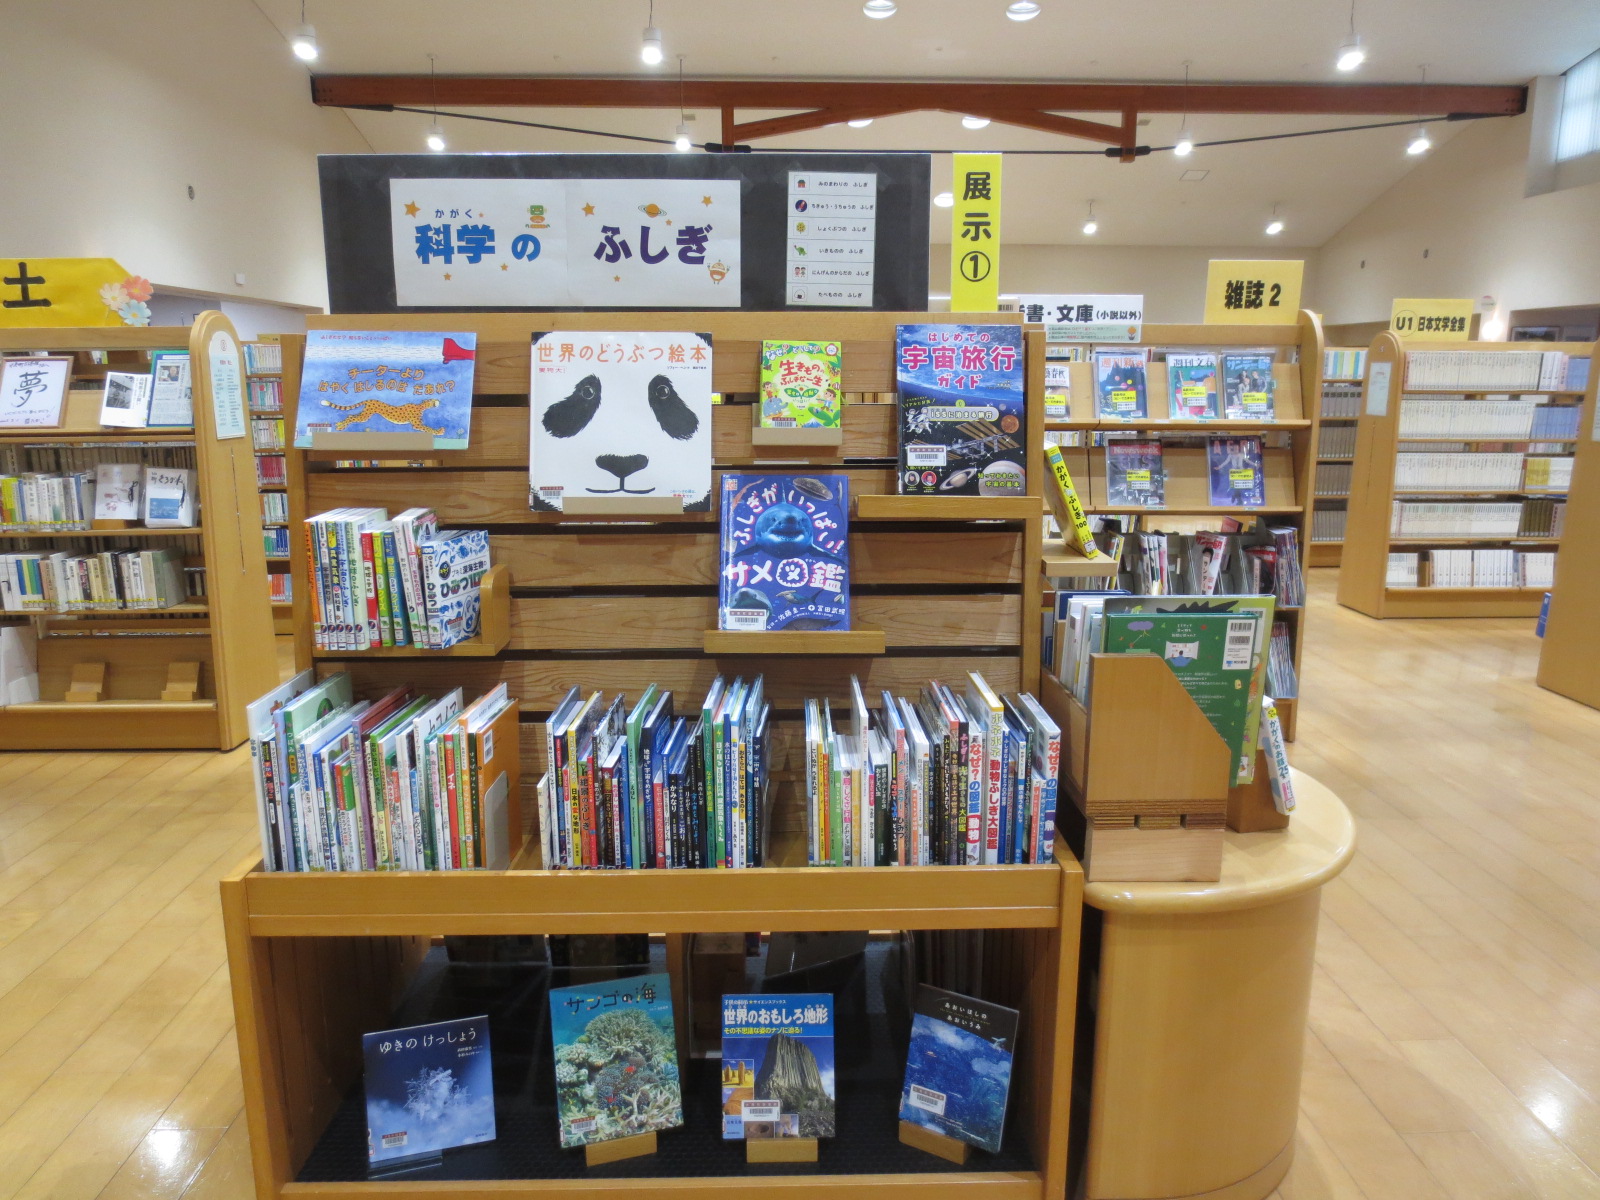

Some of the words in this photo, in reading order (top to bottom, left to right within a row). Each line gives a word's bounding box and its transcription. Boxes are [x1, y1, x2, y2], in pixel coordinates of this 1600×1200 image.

[435, 208, 472, 218] かがく
[594, 224, 713, 264] ふしぎ
[1396, 317, 1413, 330] U1
[1418, 316, 1466, 332] 日本文学全集
[928, 332, 990, 342] はじめての
[538, 343, 707, 363] 世界のどうぶつ絵本
[902, 345, 1016, 371] 宇宙旅行
[1172, 357, 1216, 368] 週刊文春
[348, 365, 426, 380] チーターより
[12, 371, 48, 408] 夢
[318, 380, 350, 394] はやく
[354, 379, 408, 394] はしるのは
[412, 380, 456, 395] だあれ?
[938, 374, 982, 389] ガイド
[1114, 446, 1160, 454] Newsweek
[447, 775, 456, 790] イネ
[968, 743, 982, 814] なぜ?の図鑑
[1047, 741, 1060, 812] なぜ?の図鑑
[986, 759, 1000, 849] 動物ふしぎ大図鑑
[968, 817, 980, 841] 動物
[564, 982, 656, 1014] サンゴの海
[724, 1008, 828, 1025] 世界のおもしろ地形
[944, 1001, 988, 1019] あおいほしの
[947, 1014, 981, 1030] あおいうみ
[380, 1038, 418, 1054] ゆきの
[423, 1027, 476, 1047] けっしょう
